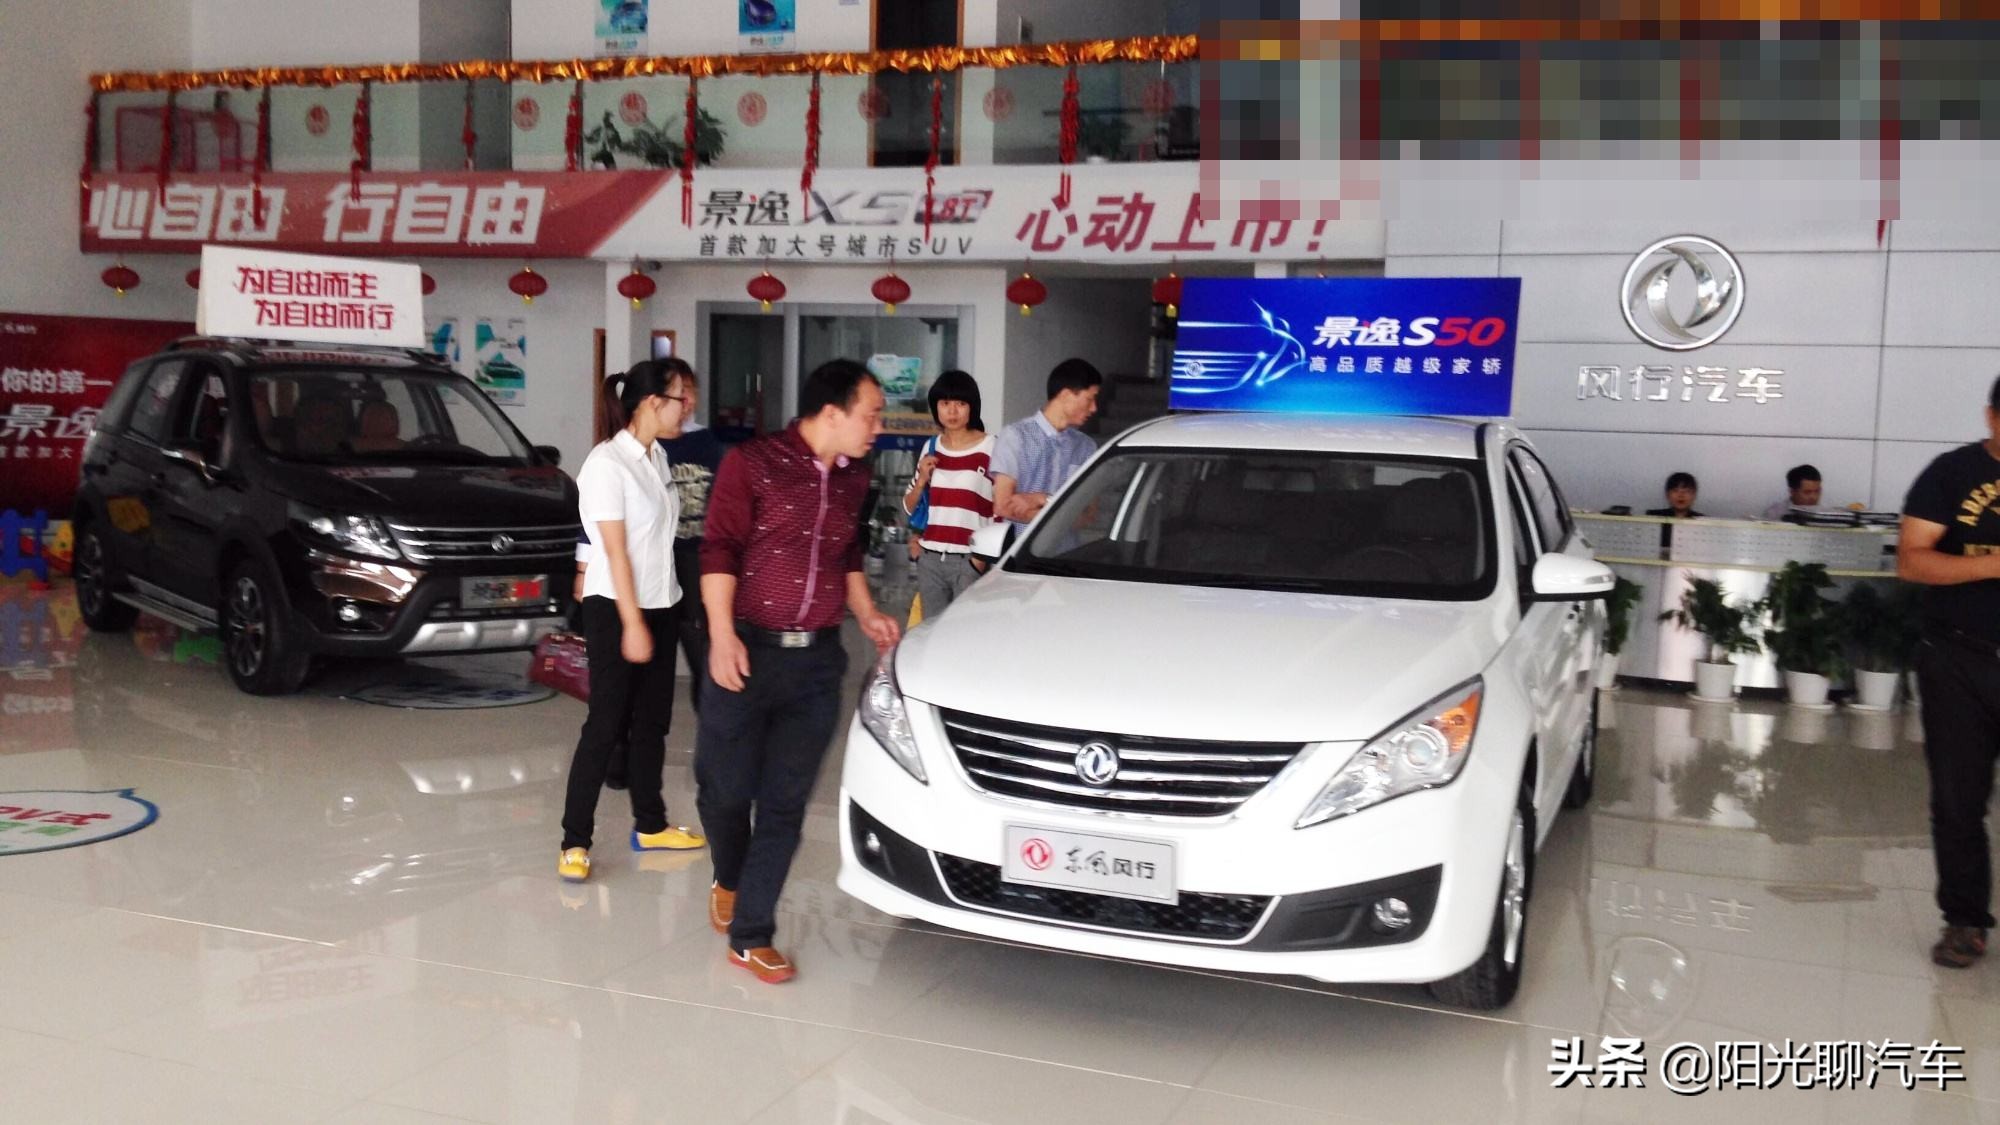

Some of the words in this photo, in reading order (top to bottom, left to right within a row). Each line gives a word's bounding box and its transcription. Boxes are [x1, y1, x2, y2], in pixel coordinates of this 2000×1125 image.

[88, 183, 287, 241] 心自由
[323, 181, 546, 245] 行自由
[699, 235, 973, 258] 首款加大号城市SUV
[237, 266, 378, 299] 为自由而生
[254, 299, 395, 330] 为自由而行
[1312, 316, 1506, 349] 景逸S50
[2, 366, 113, 394] 你的第一
[1309, 356, 1501, 375] 高品质越级家轿
[1576, 365, 1785, 404] 风行汽车
